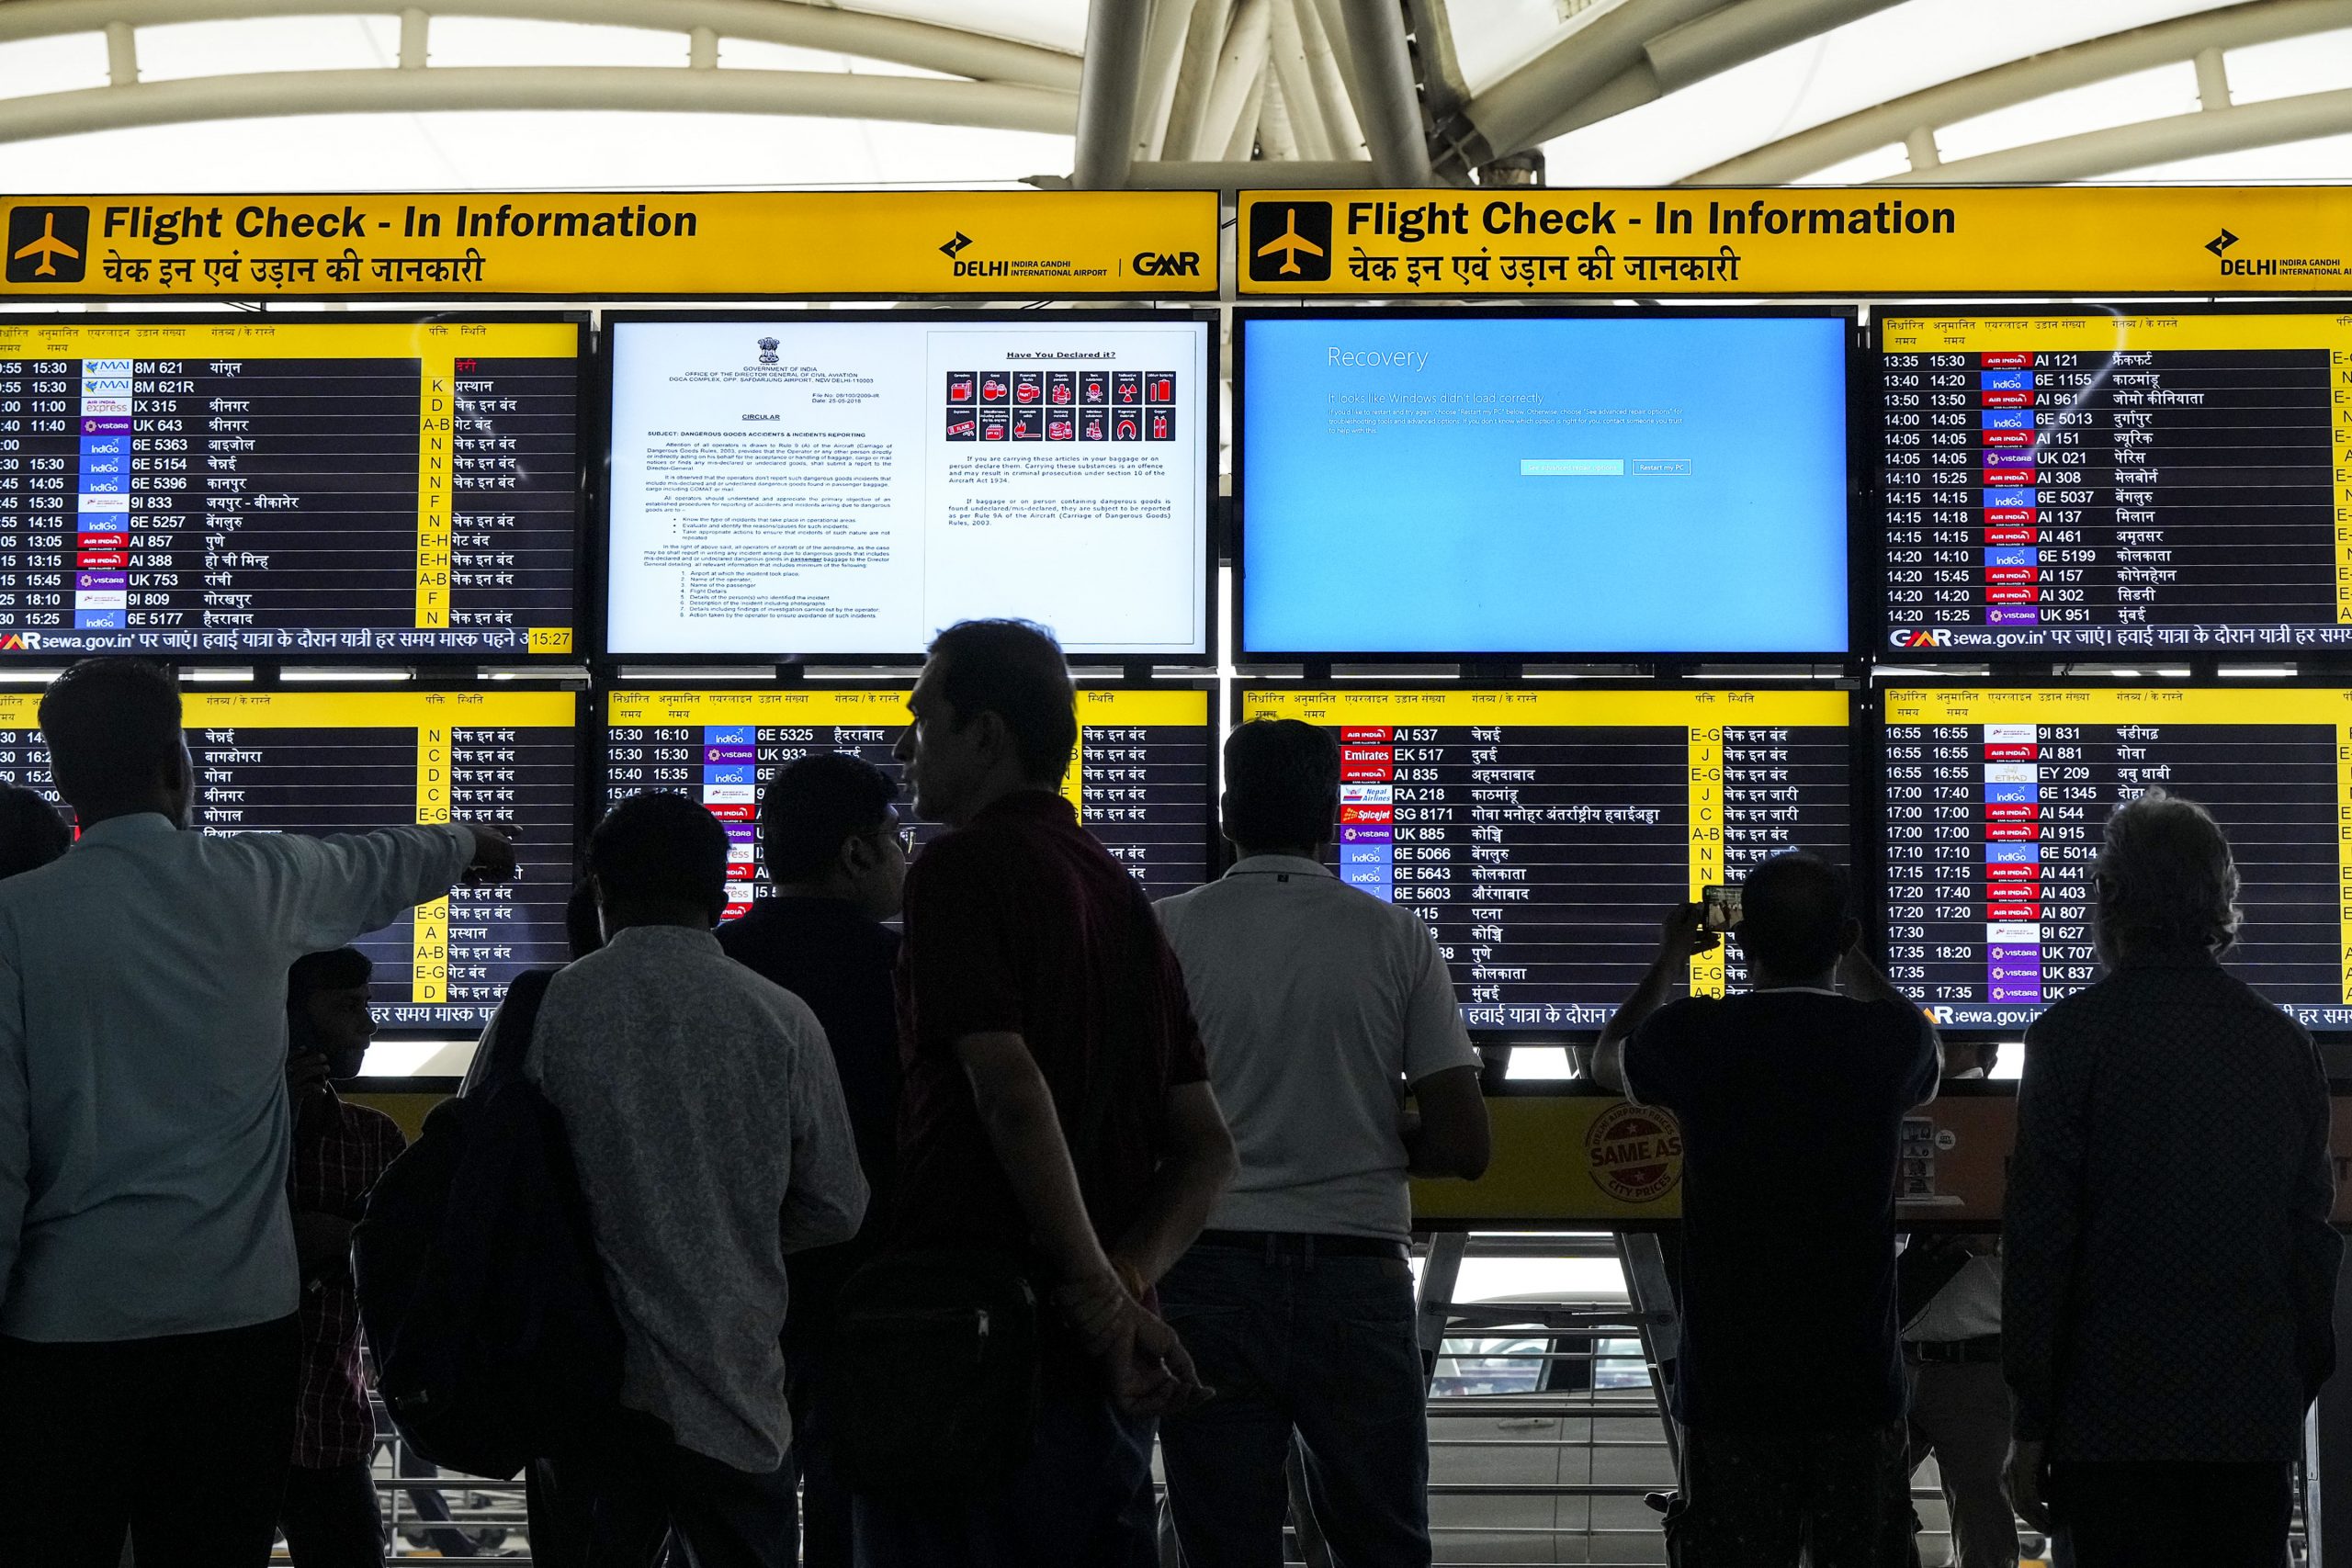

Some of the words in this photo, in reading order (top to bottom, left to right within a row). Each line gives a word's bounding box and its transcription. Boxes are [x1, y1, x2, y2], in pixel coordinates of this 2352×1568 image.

[104, 206, 222, 245] Flight
[236, 206, 366, 237] Check
[405, 206, 440, 237] In
[457, 204, 696, 237] Information
[1348, 202, 1468, 242] Flight
[1483, 201, 1616, 234] Check
[1656, 202, 1692, 234] In
[1710, 200, 1954, 234] Information
[103, 249, 152, 282] चेक
[159, 259, 196, 288] इन
[204, 250, 242, 287] एवं
[250, 259, 318, 289] उड़ान
[326, 248, 363, 282] की
[371, 248, 486, 282] जानकारी
[954, 261, 1008, 276] DELHI
[1349, 247, 1399, 281] चेक
[1406, 257, 1444, 287] इन
[1452, 247, 1491, 285] एवं
[1500, 256, 1569, 287] उड़ान
[1577, 245, 1615, 280] की
[1623, 245, 1741, 281] जानकारी
[2221, 260, 2276, 275] DELHI
[1329, 346, 1428, 372] Recovery
[1884, 356, 1918, 367] 13:35
[1930, 356, 1964, 366] 15:30
[2035, 355, 2048, 366] AI
[2055, 355, 2076, 366] 121
[1328, 394, 1334, 403] It
[1338, 394, 1366, 403] looks
[1368, 393, 1386, 403] like
[1388, 393, 1437, 403] Windows
[1473, 393, 1497, 403] load
[1498, 393, 1545, 405] correctly
[28, 536, 62, 547] 13:05
[130, 536, 143, 547] AI
[148, 532, 173, 547] 857
[206, 533, 225, 550] पुणे
[421, 534, 447, 546] E-H
[452, 532, 469, 546] गेट
[472, 533, 490, 546] बंद
[26, 614, 59, 624] 15:25
[128, 613, 145, 624] 6E
[150, 613, 183, 624] 5177
[202, 609, 254, 627] हैदराबाद
[428, 612, 437, 624] N
[450, 610, 471, 624] चेक
[474, 614, 492, 625] इन
[495, 610, 513, 624] बंद
[139, 634, 159, 647] पर
[202, 629, 239, 649] हवाई
[242, 634, 273, 647] यात्रा
[277, 629, 293, 647] के
[297, 629, 337, 647] दौरान
[340, 629, 372, 646] यात्री
[375, 633, 396, 648] हर
[399, 633, 435, 646] समय
[439, 633, 479, 646] मास्क
[482, 629, 515, 648] पहने
[531, 633, 569, 645] 15:27
[659, 693, 701, 706] अनुमानित
[609, 729, 642, 740] 15:30
[655, 729, 688, 740] 16:10
[758, 729, 775, 740] 6E
[780, 729, 813, 740] 5325
[834, 727, 884, 744] हैदराबाद
[205, 748, 262, 762] बागडोगरा
[429, 749, 439, 762] C
[452, 748, 473, 761] चेक
[476, 751, 494, 762] इन
[497, 748, 514, 761] बंद
[1345, 750, 1388, 760] Emirates
[1395, 749, 1415, 760] EK
[1419, 749, 1443, 760] 517
[1472, 747, 1497, 764] दुबई
[1702, 749, 1709, 761] J
[1887, 767, 1921, 778] 16:55
[1934, 767, 1968, 778] 16:55
[2040, 767, 2060, 778] EY
[2064, 767, 2089, 778] 209
[2118, 769, 2138, 782] अबु
[2142, 765, 2171, 779] धाबी
[1395, 808, 1416, 820] SG
[1420, 808, 1452, 820] 8171
[1472, 806, 1500, 820] गोवा
[1503, 806, 1543, 825] मनोहर
[1701, 808, 1711, 820] C
[1724, 806, 1746, 820] चेक
[1749, 810, 1767, 822] इन
[1770, 806, 1799, 820] जारी
[1888, 887, 1923, 897] 17:20
[1935, 887, 1970, 898] 17:40
[2041, 887, 2055, 898] AI
[2060, 887, 2085, 898] 403
[426, 927, 436, 938] A
[449, 928, 487, 939] प्रस्थान
[1591, 1142, 1651, 1167] SAME
[1655, 1137, 1682, 1157] AS
[1609, 1179, 1633, 1196] CITY
